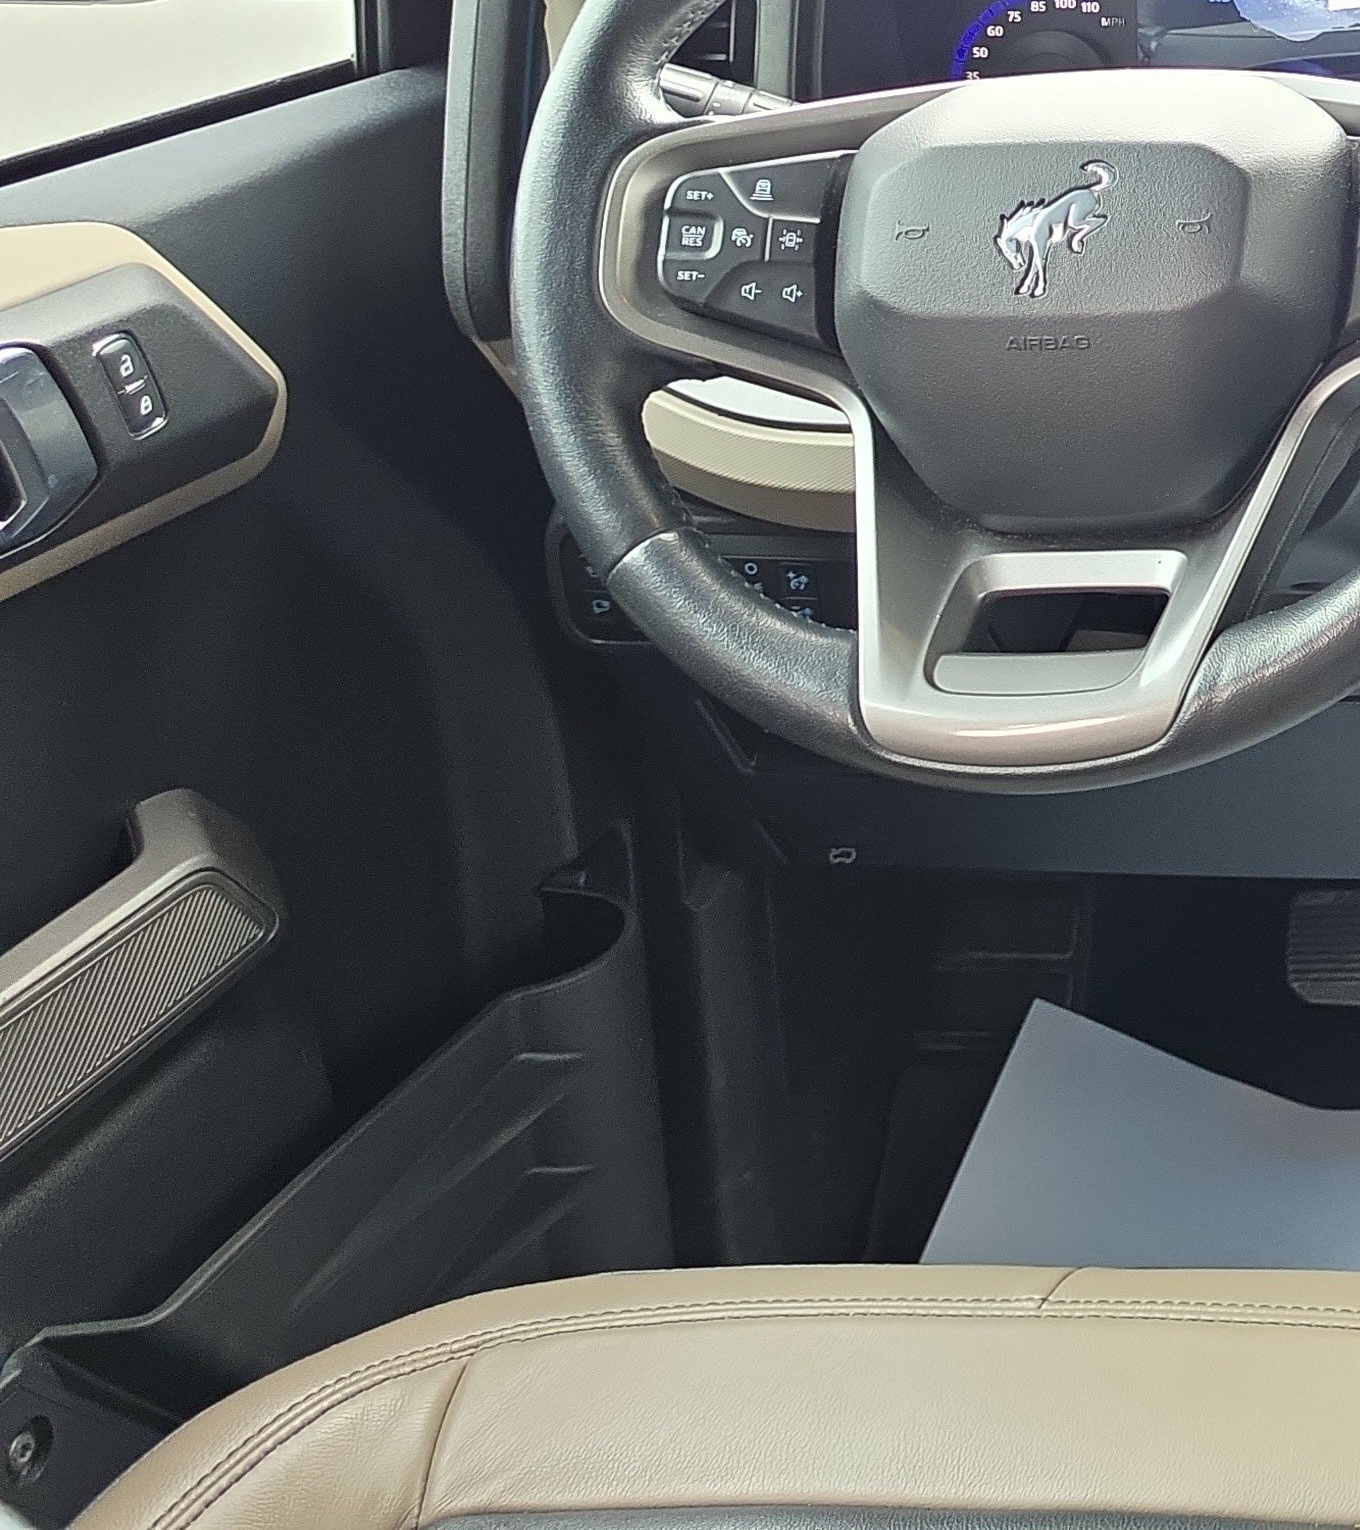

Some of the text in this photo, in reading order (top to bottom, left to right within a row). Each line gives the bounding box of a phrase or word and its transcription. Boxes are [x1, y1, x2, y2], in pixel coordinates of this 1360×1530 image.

[1030, 1, 1046, 12] 85
[1081, 1, 1100, 13] 110
[1007, 11, 1022, 23] 75
[1101, 17, 1126, 27] MPH
[987, 25, 1004, 37] 60
[972, 47, 988, 58] 50
[681, 225, 706, 235] CAN
[681, 237, 703, 247] RES
[1005, 335, 1091, 350] AIRBAG
